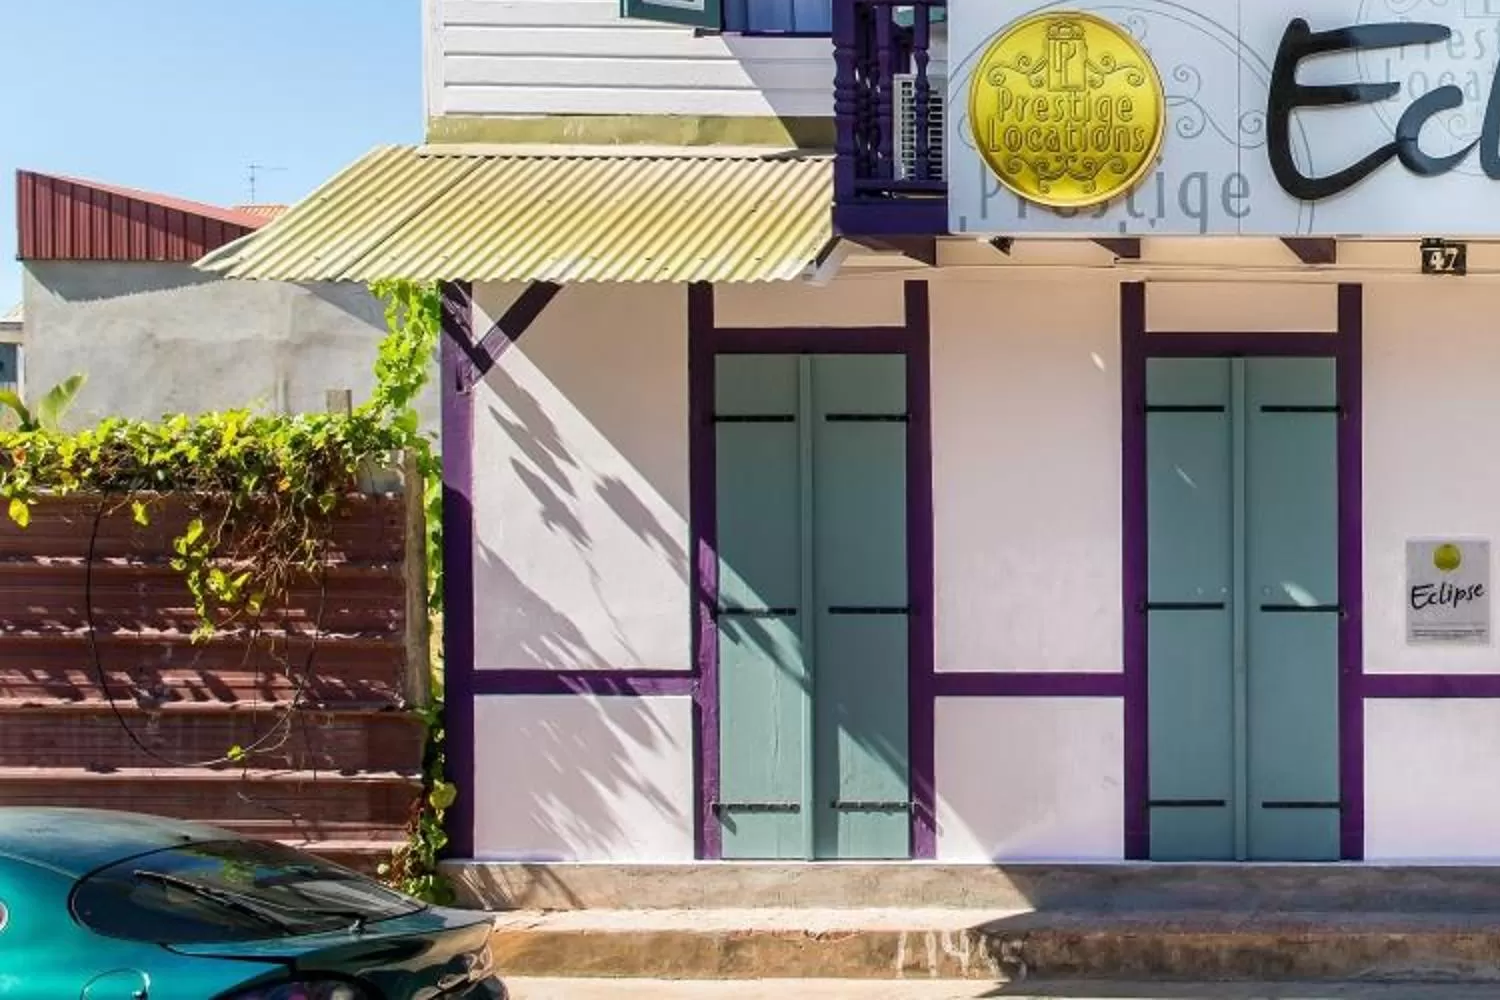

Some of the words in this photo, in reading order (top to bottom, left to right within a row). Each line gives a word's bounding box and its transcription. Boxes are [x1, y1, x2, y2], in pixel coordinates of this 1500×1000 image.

[997, 85, 1134, 130] Prestige
[988, 115, 1146, 153] Locations
[1430, 247, 1459, 271] 47
[1411, 582, 1485, 610] Eclipse
